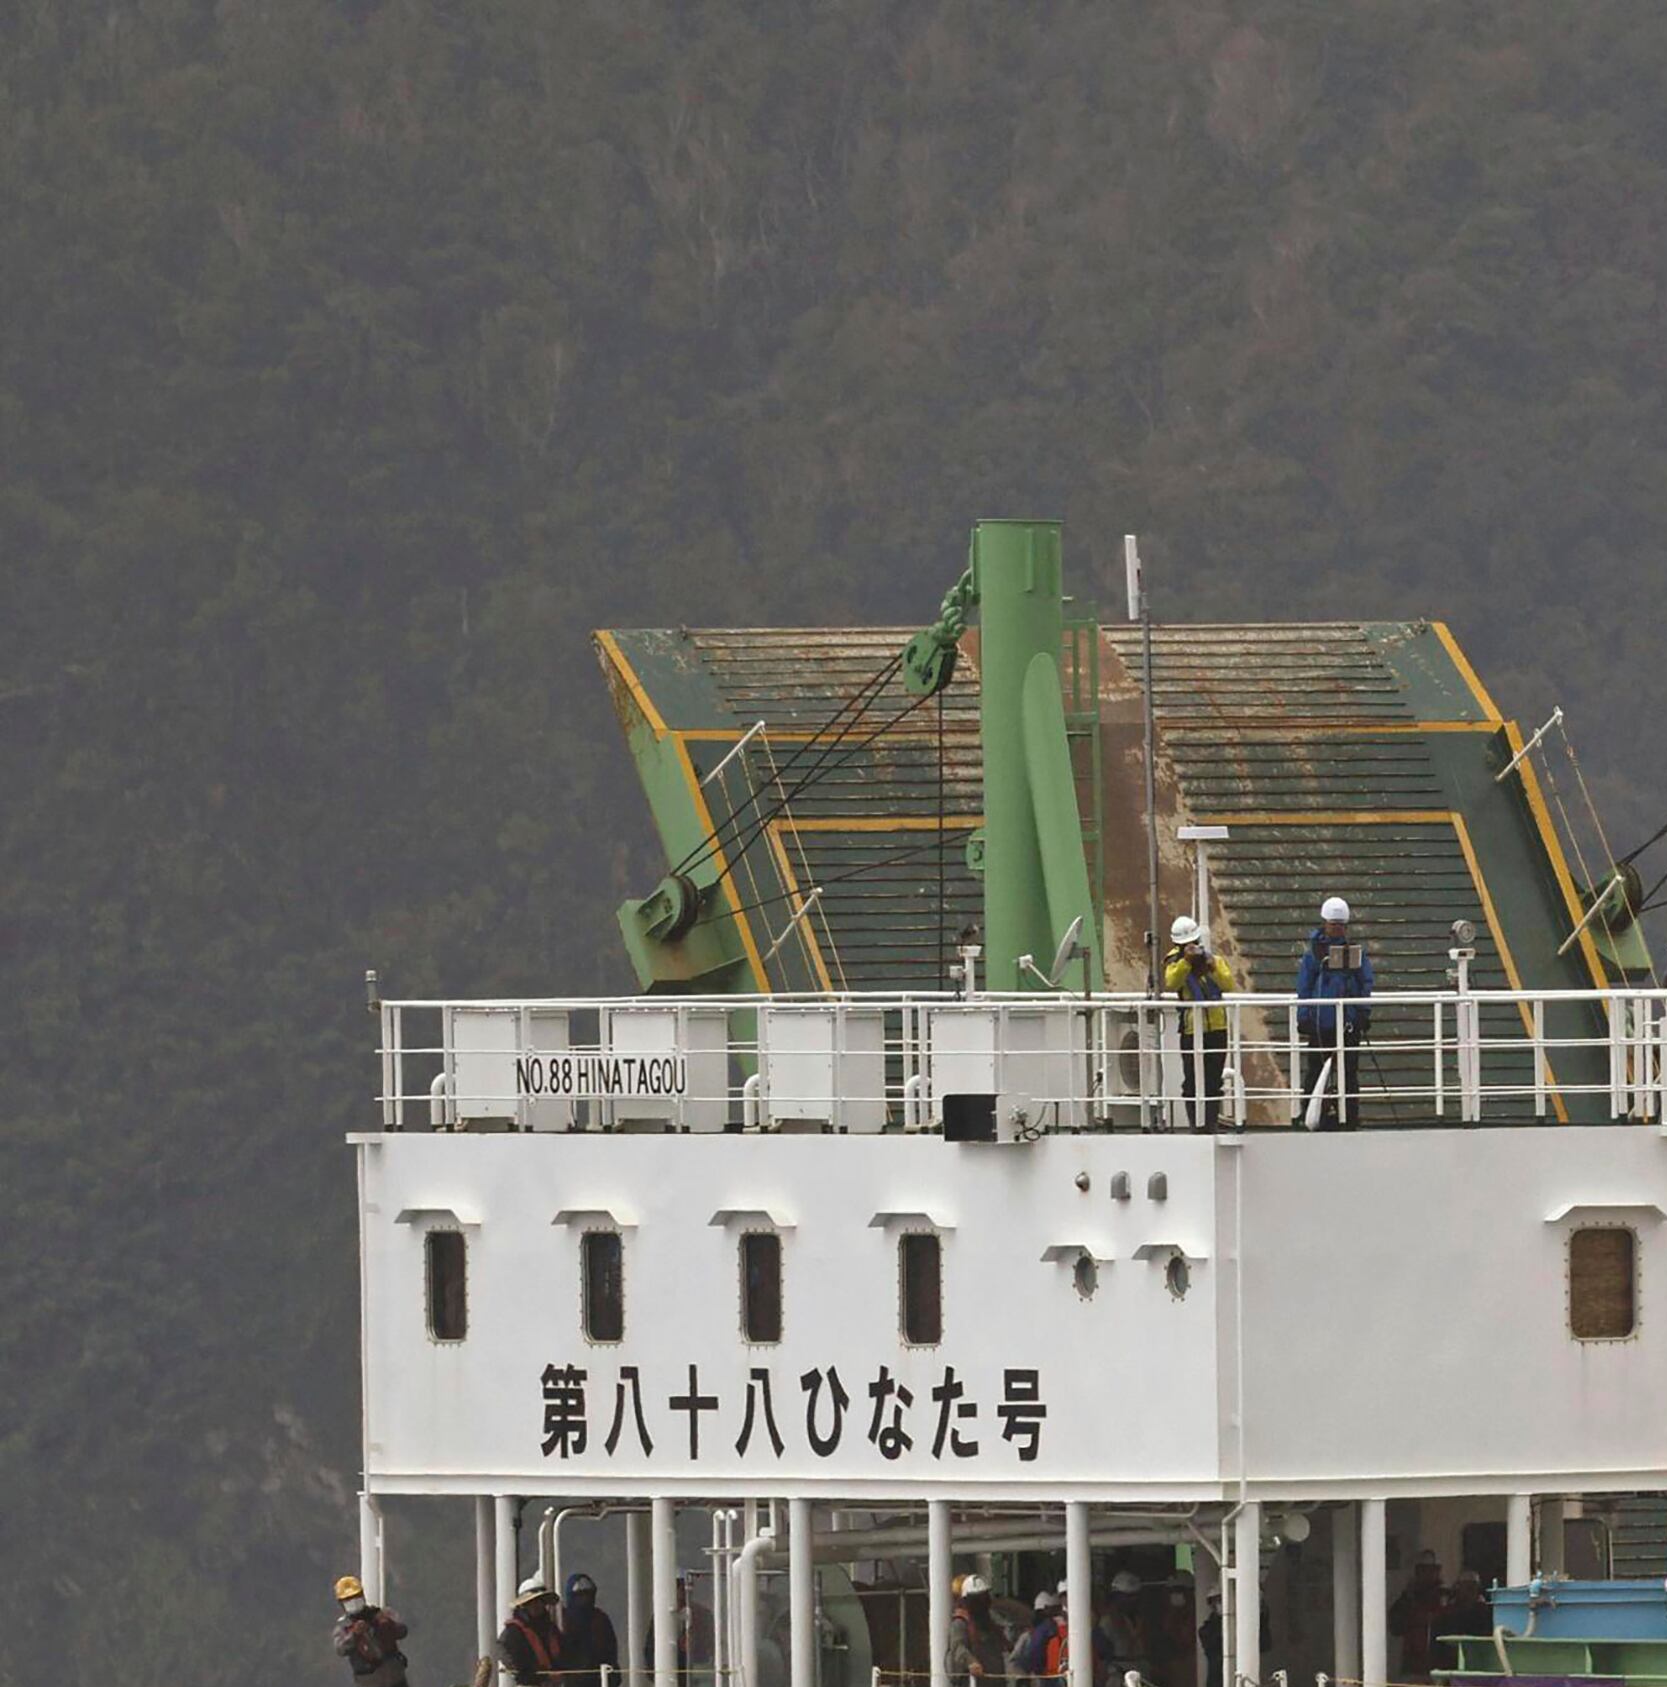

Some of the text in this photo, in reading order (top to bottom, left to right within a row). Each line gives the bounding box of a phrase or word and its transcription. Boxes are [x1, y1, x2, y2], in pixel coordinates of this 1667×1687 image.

[516, 1058, 686, 1094] NO.88 HINATAGOU
[540, 1363, 1048, 1462] 第八十八ひなた号
